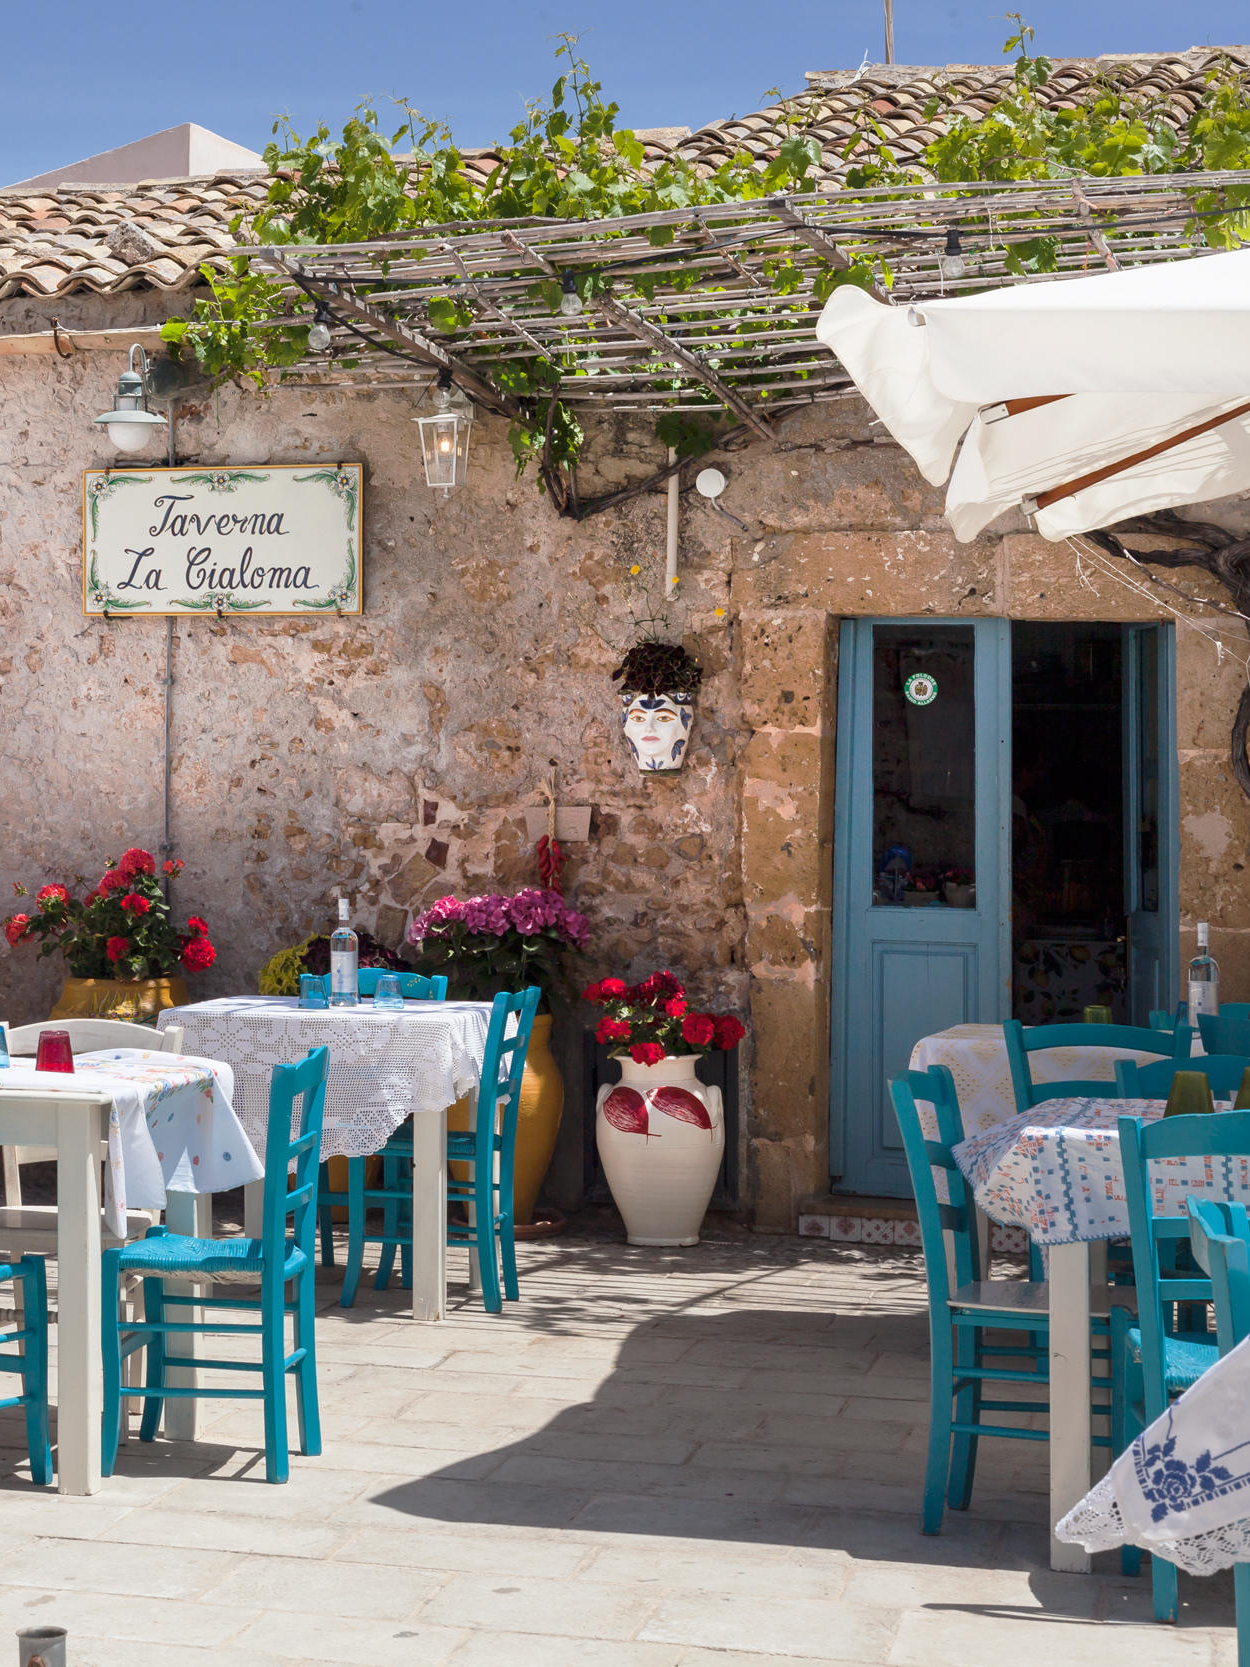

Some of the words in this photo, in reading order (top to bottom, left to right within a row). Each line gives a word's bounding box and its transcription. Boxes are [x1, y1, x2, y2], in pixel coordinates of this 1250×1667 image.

[149, 494, 290, 537] Taverna
[116, 547, 168, 591] La
[185, 546, 320, 591] Cialoma
